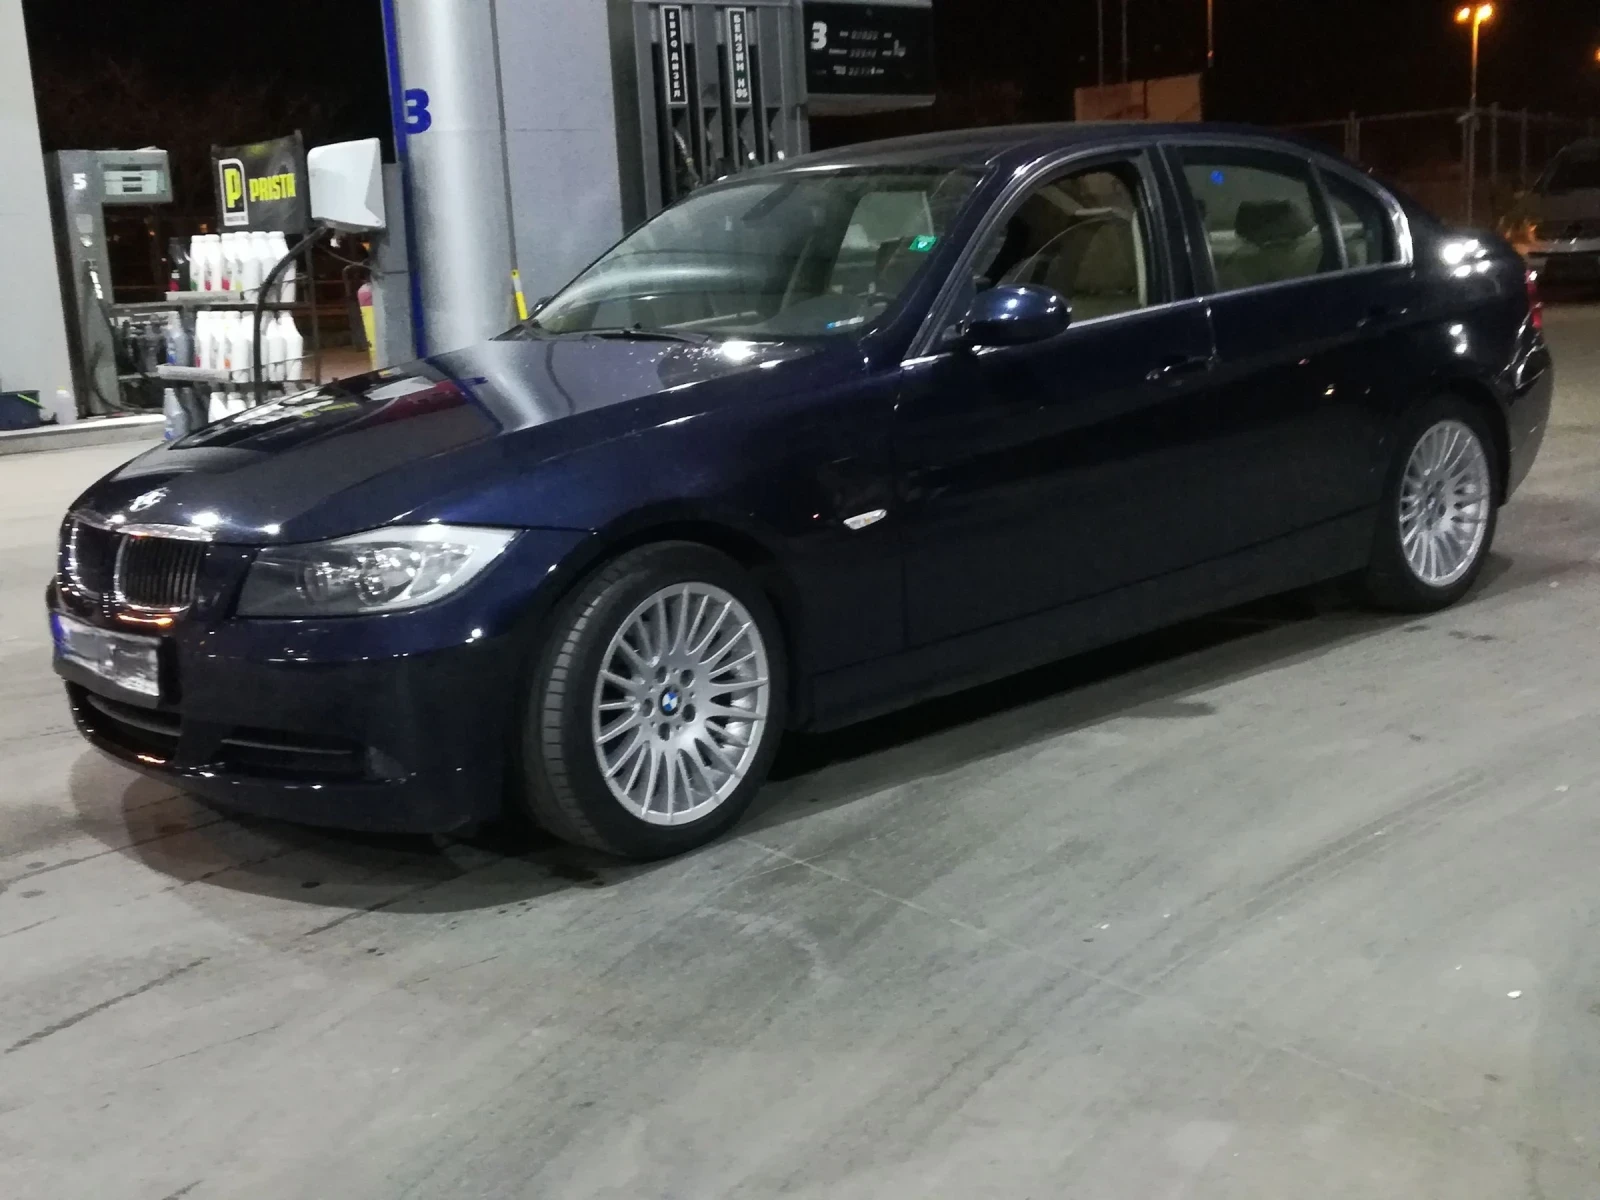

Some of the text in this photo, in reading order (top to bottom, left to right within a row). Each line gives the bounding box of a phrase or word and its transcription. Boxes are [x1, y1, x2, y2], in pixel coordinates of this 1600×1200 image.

[810, 21, 827, 50] 3
[403, 88, 432, 134] 3
[72, 173, 87, 190] 5
[249, 173, 296, 202] PRISTA
